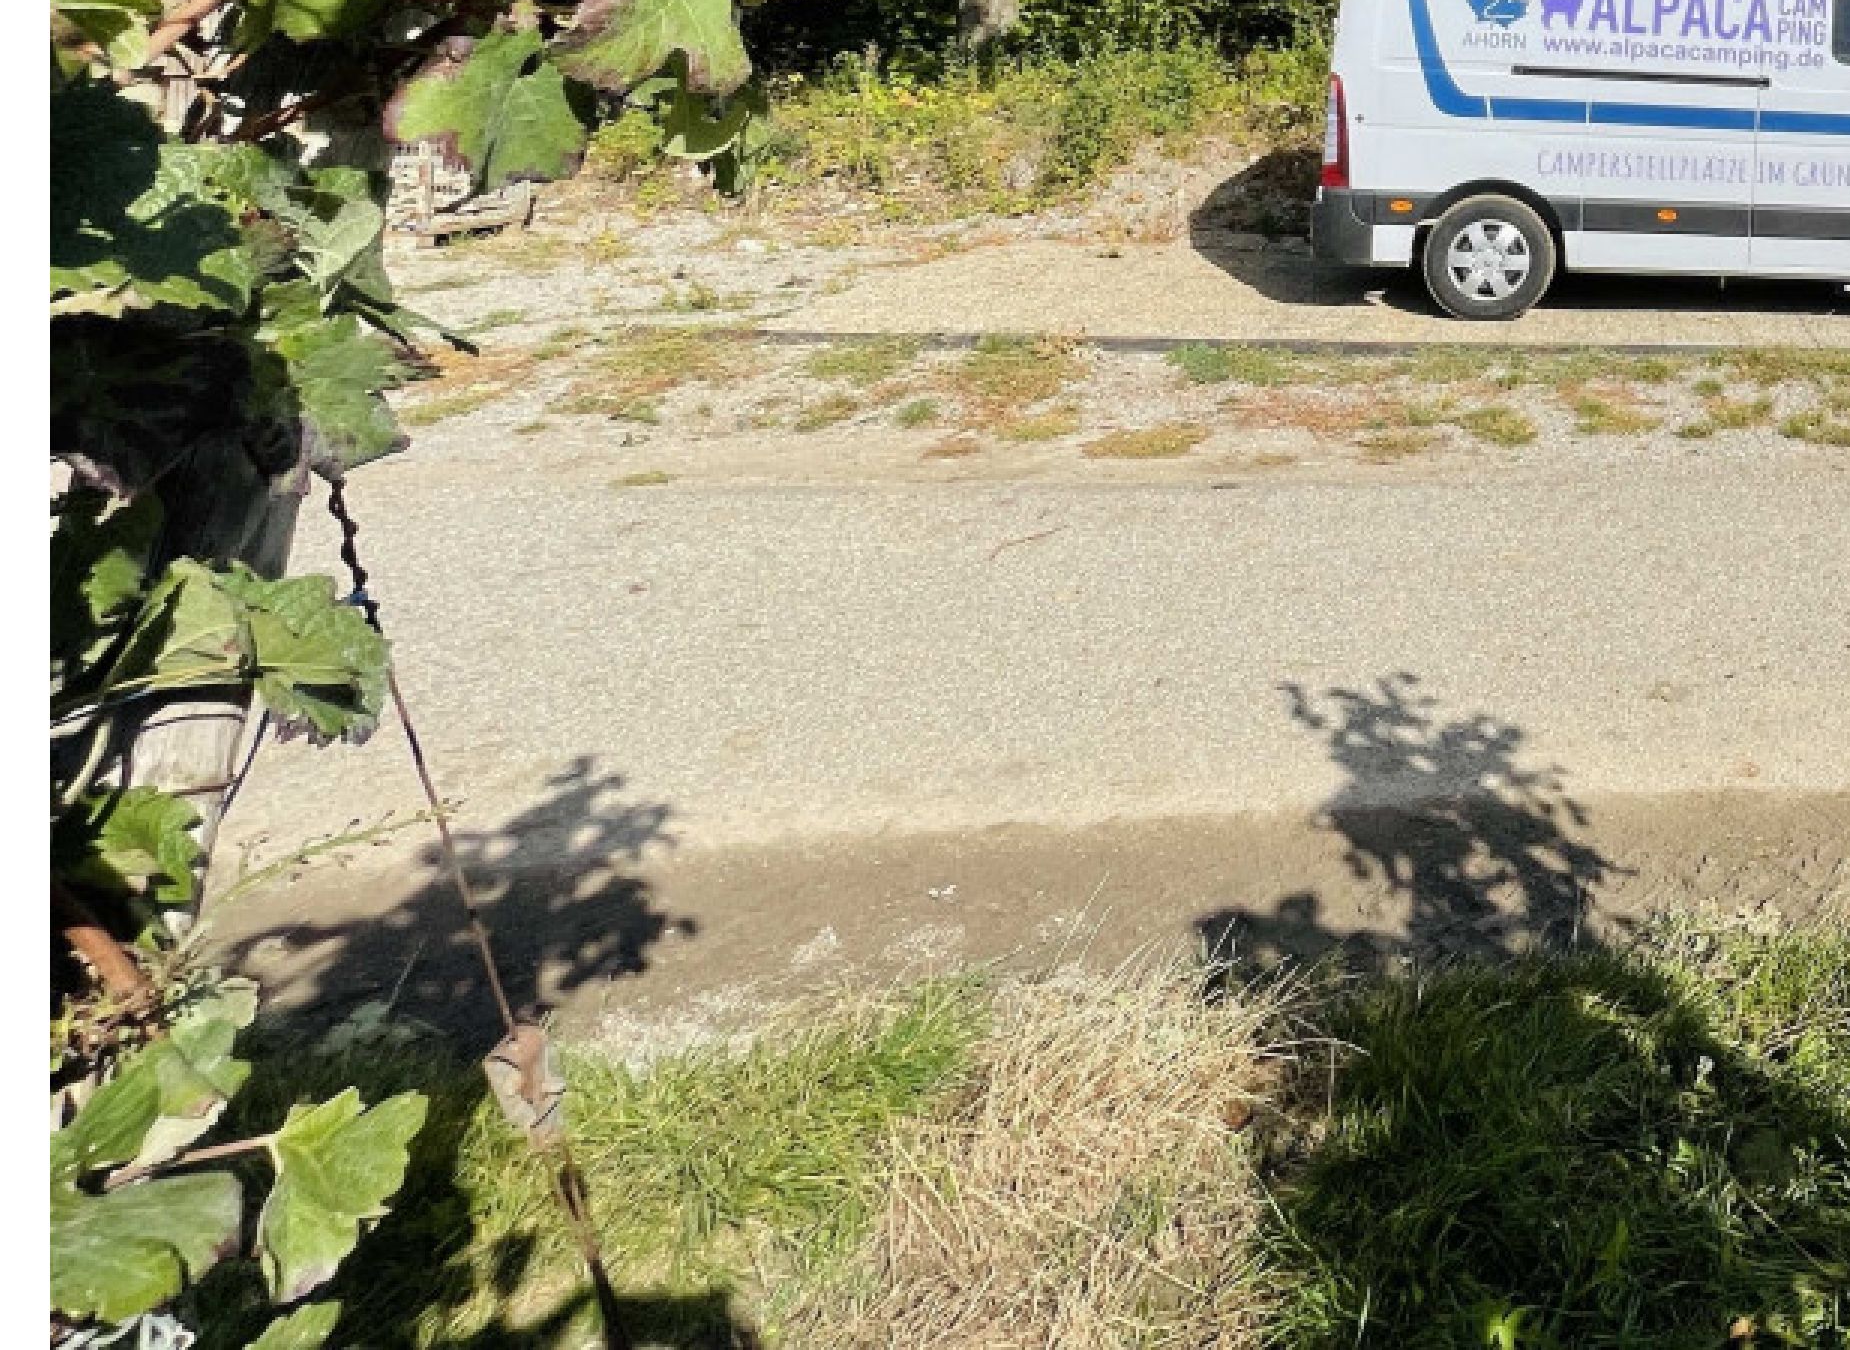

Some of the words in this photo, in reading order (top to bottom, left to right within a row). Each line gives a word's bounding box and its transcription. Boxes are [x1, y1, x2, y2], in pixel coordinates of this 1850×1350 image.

[1462, 32, 1527, 50] AHORN
[1777, 18, 1827, 46] PING
[1543, 36, 1824, 70] www.alpacacamping.de
